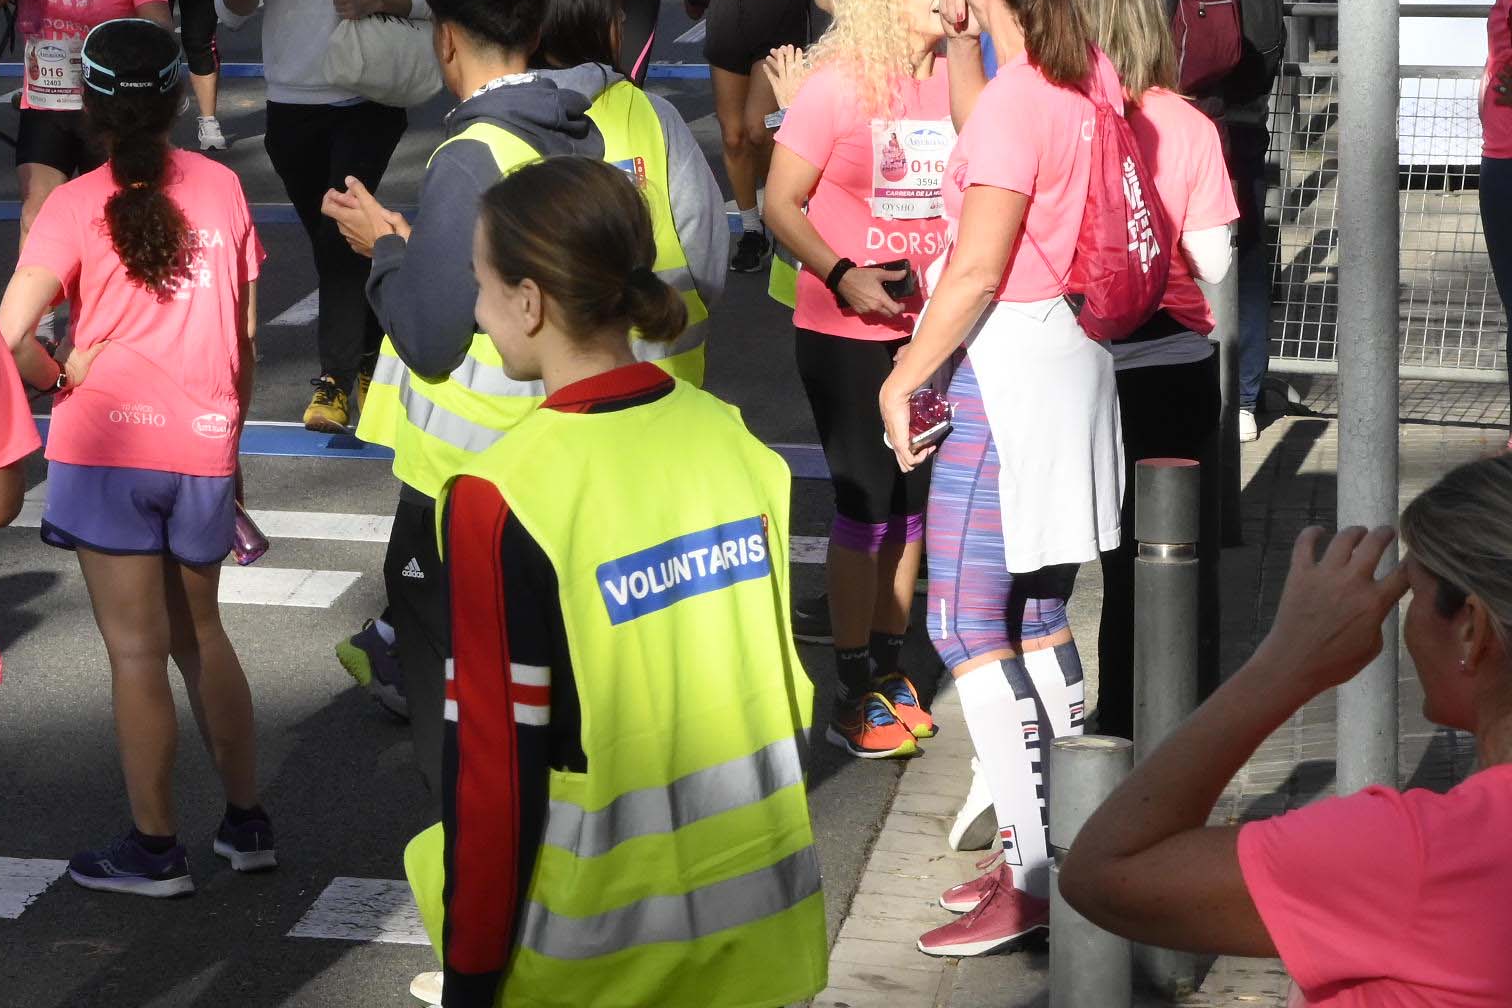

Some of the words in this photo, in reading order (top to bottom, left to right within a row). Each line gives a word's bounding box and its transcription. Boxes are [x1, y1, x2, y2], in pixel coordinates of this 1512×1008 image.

[40, 67, 64, 78] 016
[911, 159, 945, 173] 016
[916, 177, 938, 187] 3594
[882, 202, 915, 212] OYSHO
[109, 410, 166, 427] OYSHO
[604, 534, 766, 606] VOLUNTARIS
